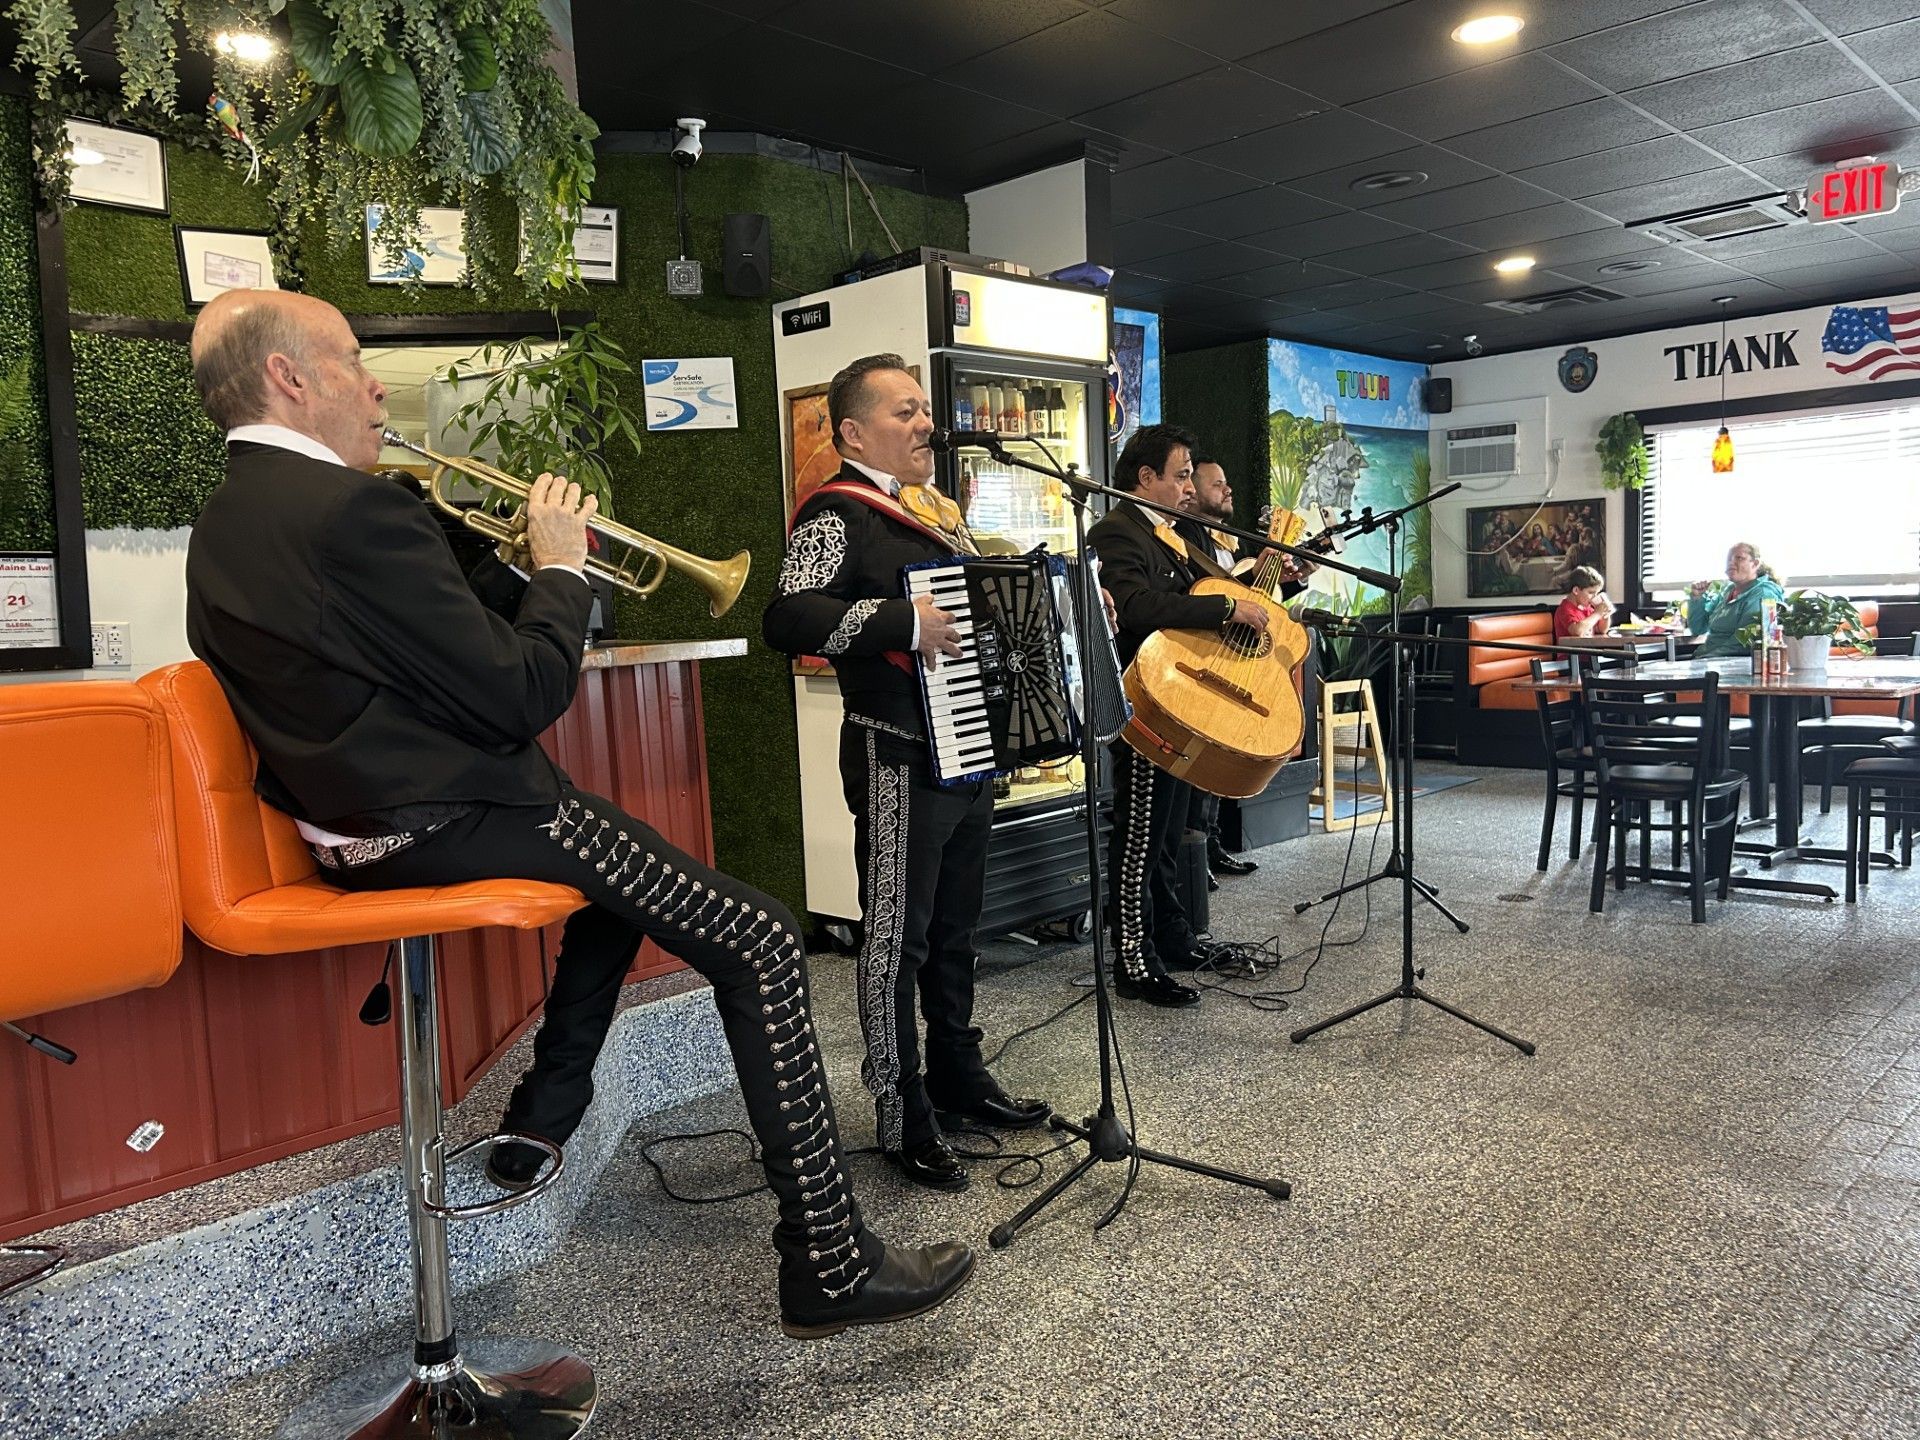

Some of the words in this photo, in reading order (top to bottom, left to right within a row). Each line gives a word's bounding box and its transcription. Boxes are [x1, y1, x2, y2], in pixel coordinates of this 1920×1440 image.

[1823, 164, 1888, 218] EXIT
[801, 309, 822, 326] WiFi
[1663, 329, 1800, 381] THANK
[1336, 369, 1390, 400] TULUM
[7, 595, 26, 606] 21
